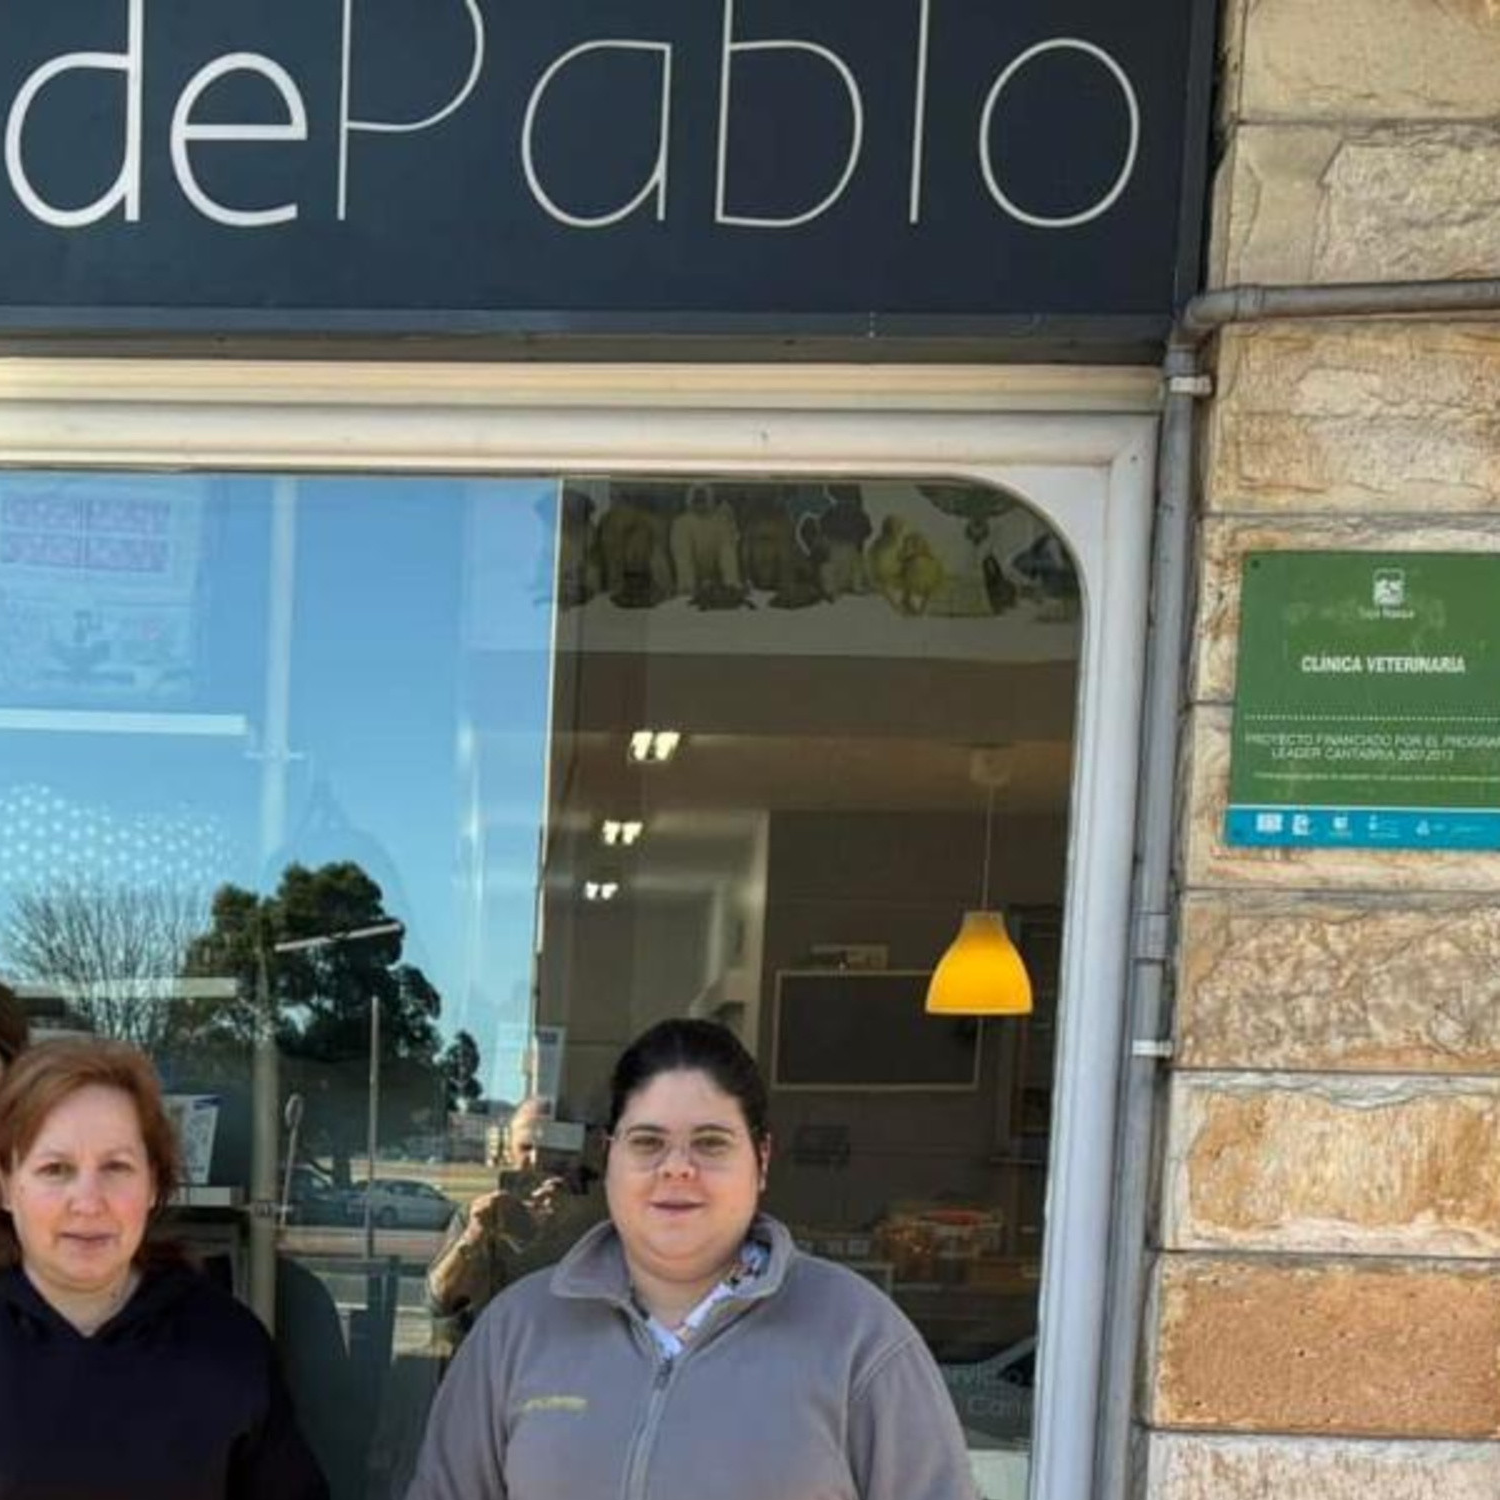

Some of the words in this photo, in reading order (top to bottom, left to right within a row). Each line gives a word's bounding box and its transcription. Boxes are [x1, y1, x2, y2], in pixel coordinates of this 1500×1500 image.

[1366, 655, 1466, 674] VETERINARIA
[1244, 733, 1313, 747] PROYECTO
[1316, 734, 1391, 748] FINANCIADO
[1394, 735, 1421, 749] POR
[1425, 736, 1438, 750] EL
[1271, 747, 1321, 760] LEADER
[1324, 747, 1395, 761] CANTABRIA
